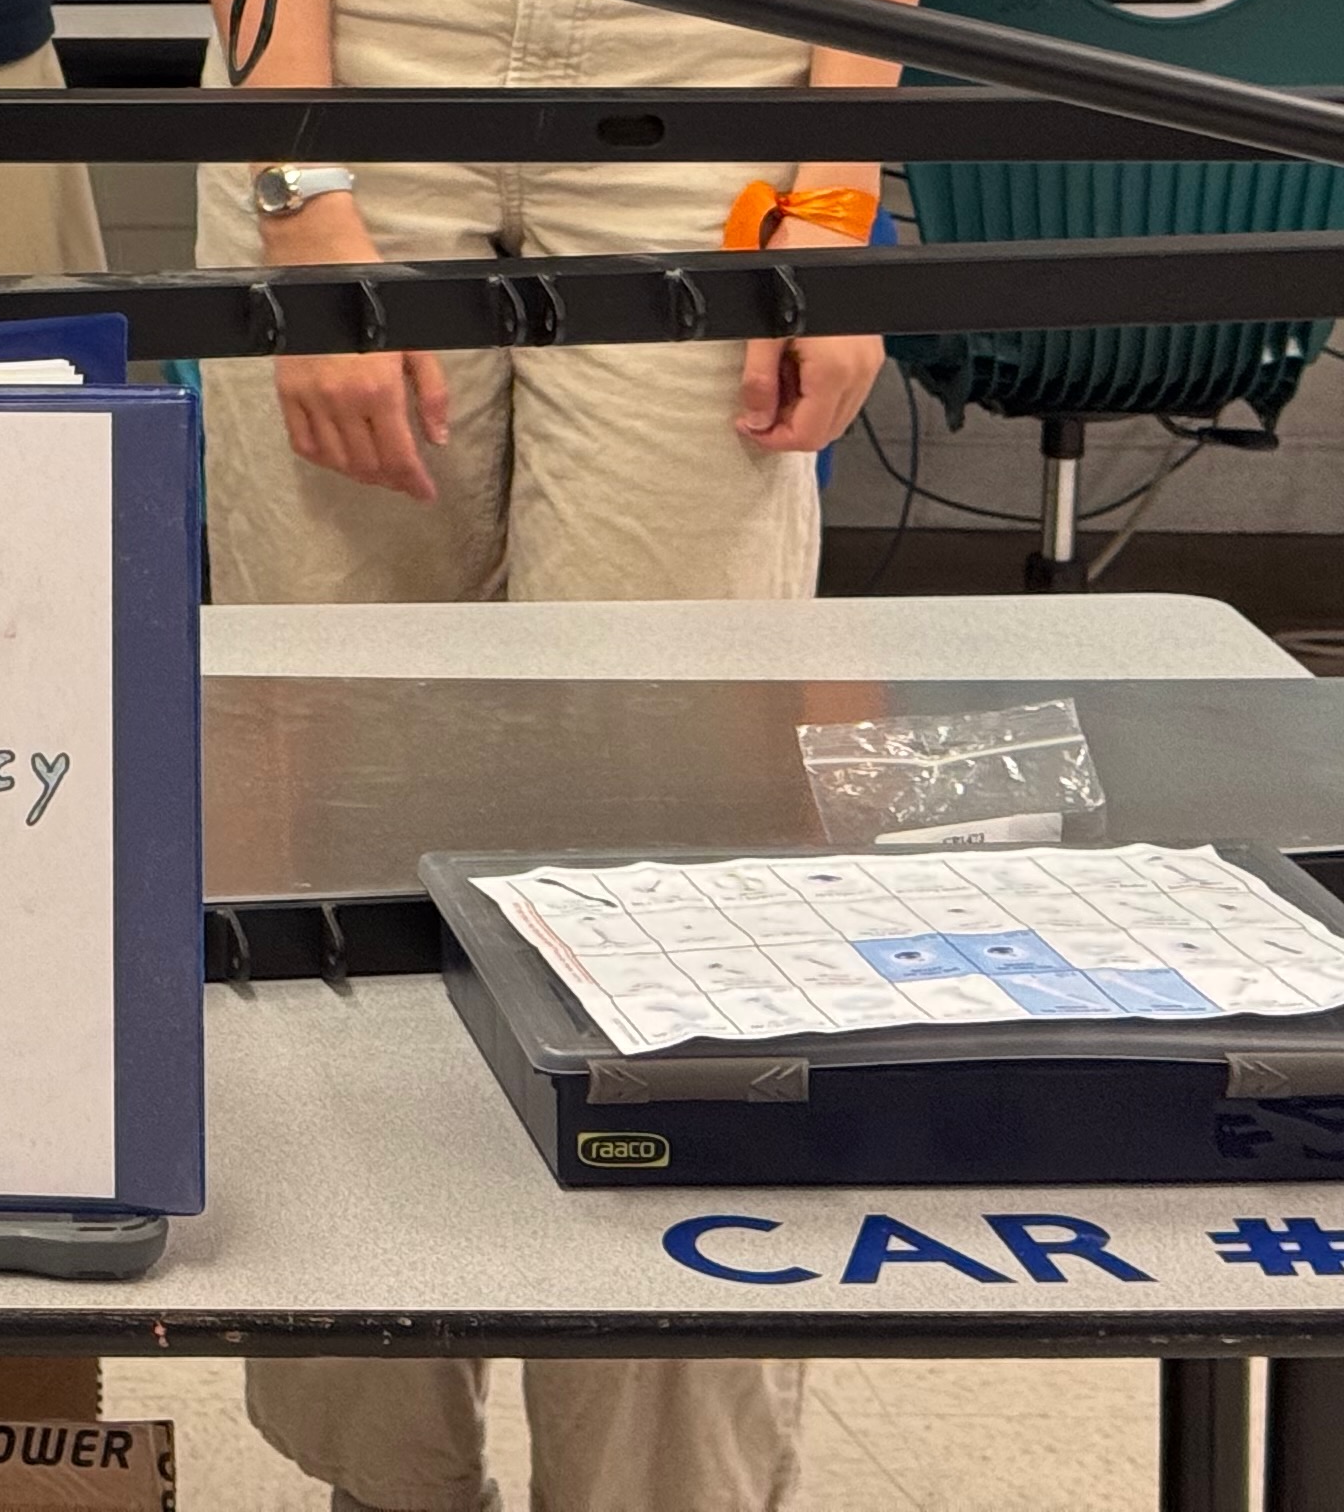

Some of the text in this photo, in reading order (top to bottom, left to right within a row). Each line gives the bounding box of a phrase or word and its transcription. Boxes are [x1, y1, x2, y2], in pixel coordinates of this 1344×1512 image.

[591, 1141, 655, 1159] raaco
[660, 1213, 1344, 1285] CAR #
